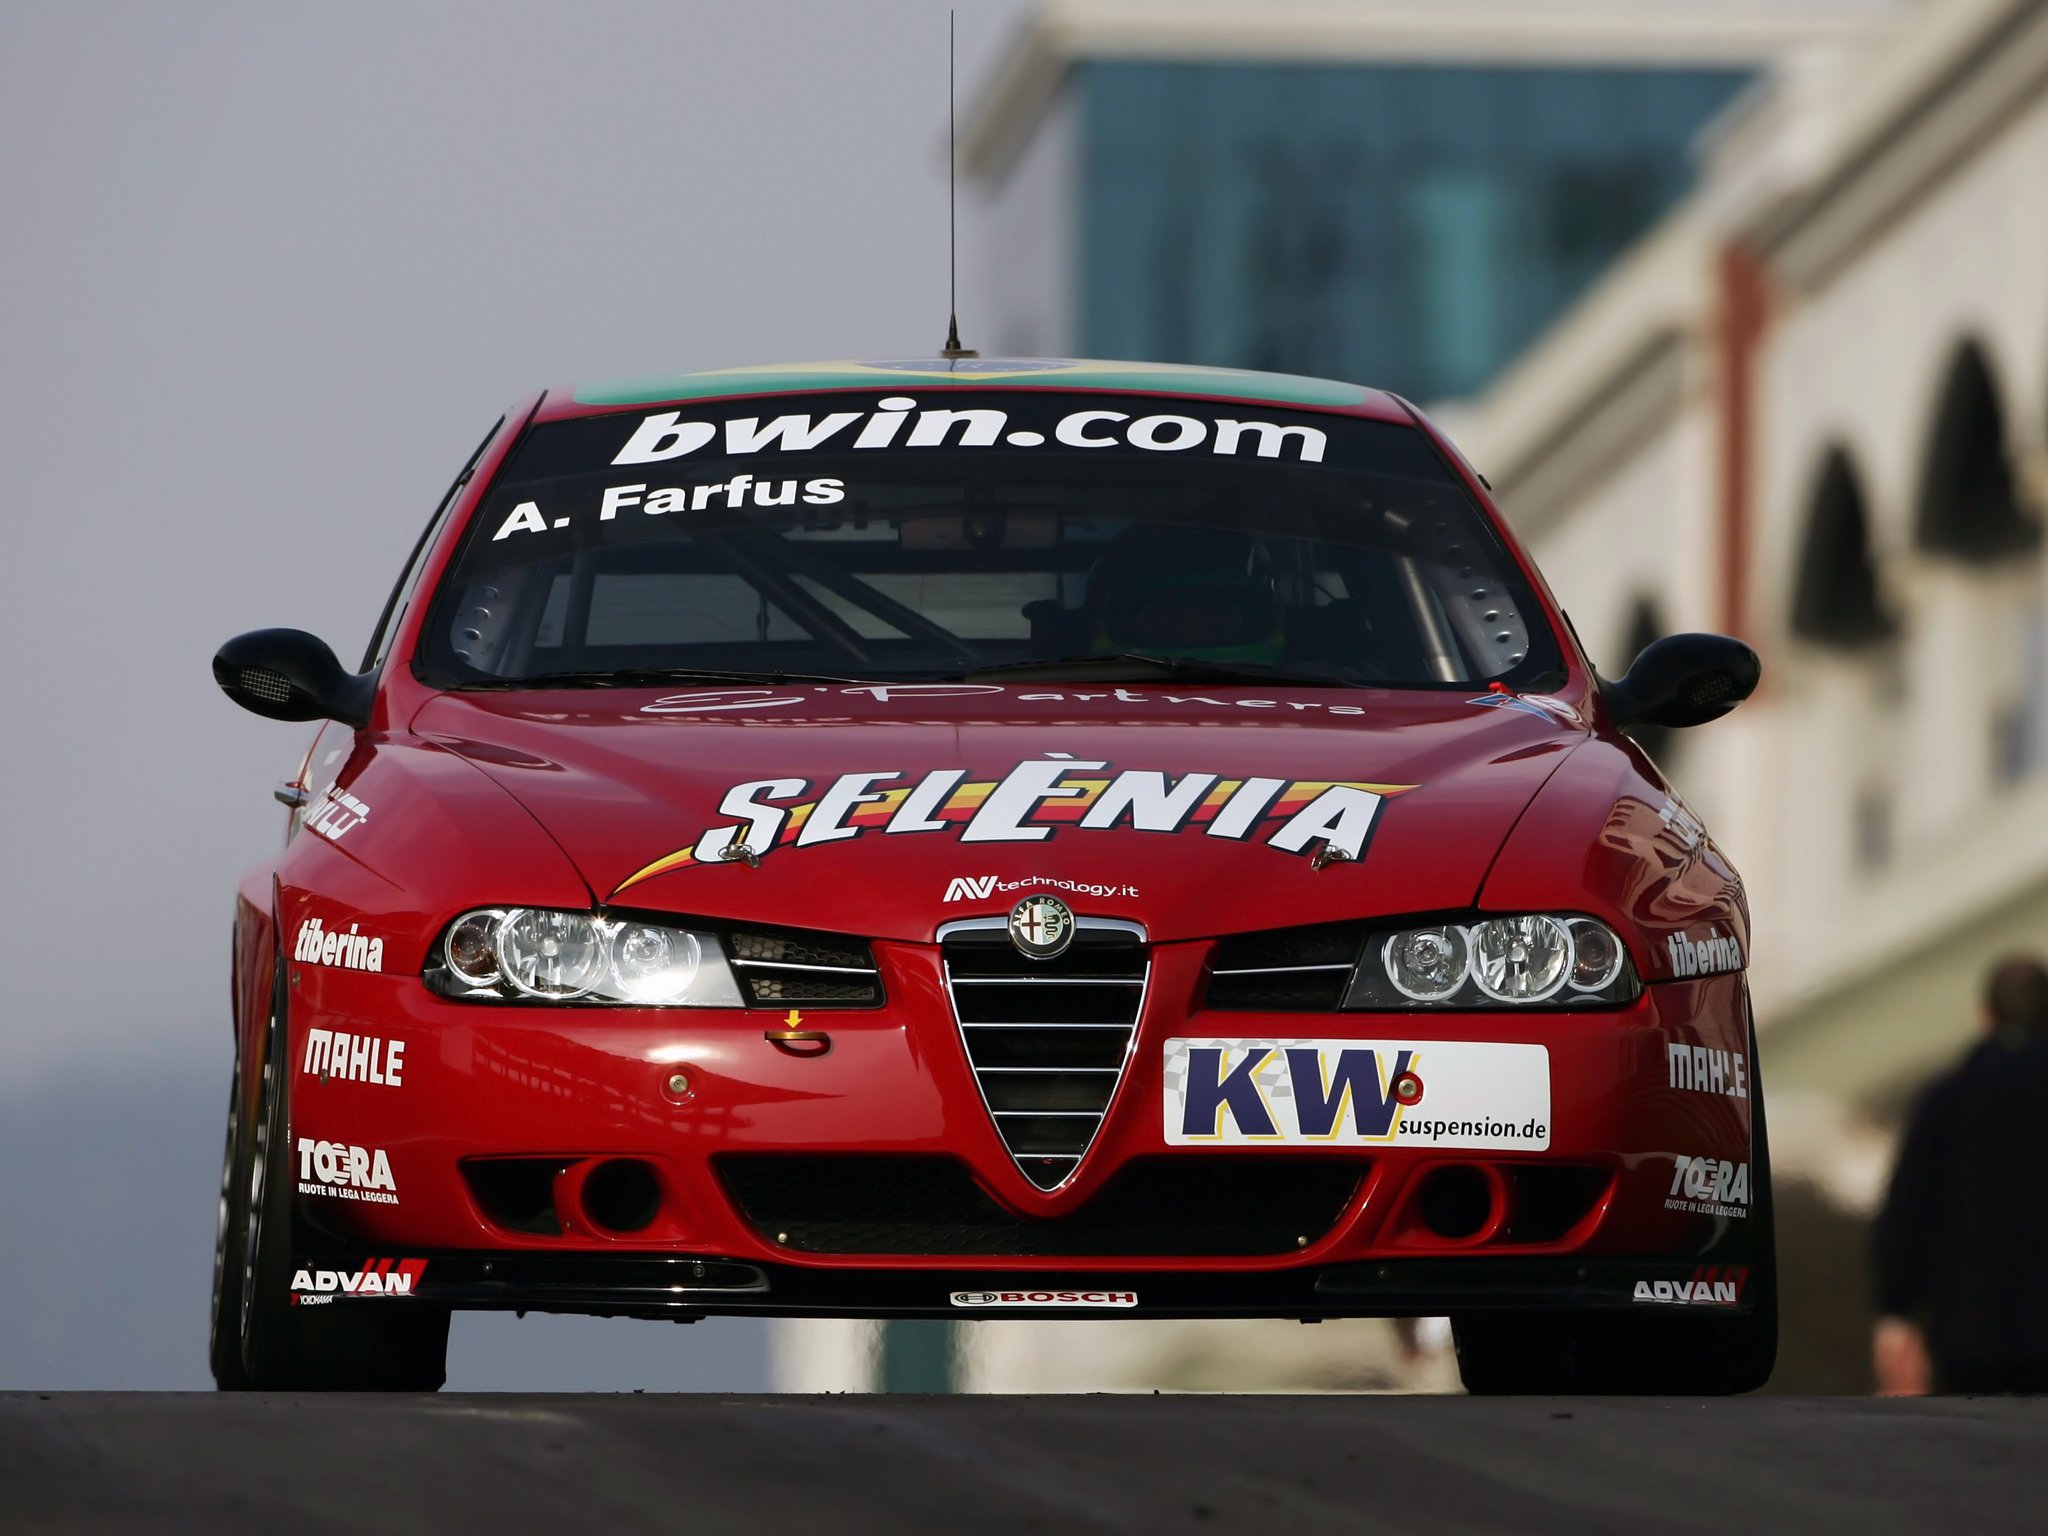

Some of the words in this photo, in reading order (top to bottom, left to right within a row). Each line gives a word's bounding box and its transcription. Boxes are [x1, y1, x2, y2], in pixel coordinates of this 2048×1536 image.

[610, 396, 1327, 465] bwin.com
[493, 501, 571, 542] A.
[599, 474, 845, 521] Farfus
[694, 753, 1384, 863] SELÈNIA
[1013, 901, 1034, 927] ALFA
[1039, 897, 1070, 925] ROMEO
[294, 917, 384, 973] tiberina
[1667, 928, 1741, 978] tiberina
[303, 1028, 405, 1087] MAHLE
[1668, 1042, 1747, 1098] MAHLE
[1182, 1048, 1420, 1139] KW
[1399, 1115, 1546, 1140] suspension.de
[299, 1183, 327, 1195] RUOTE
[328, 1186, 337, 1197] IN
[338, 1188, 360, 1200] LEGA
[361, 1190, 399, 1205] LEGGERA
[1664, 1198, 1688, 1211] RUOTE
[1688, 1201, 1697, 1213] IN
[1697, 1203, 1714, 1215] LEGA
[1715, 1205, 1747, 1219] LEGGERA
[290, 1269, 412, 1292] ADVAN
[1000, 1292, 1134, 1303] BOSCH
[1633, 1280, 1736, 1302] ADVAN
